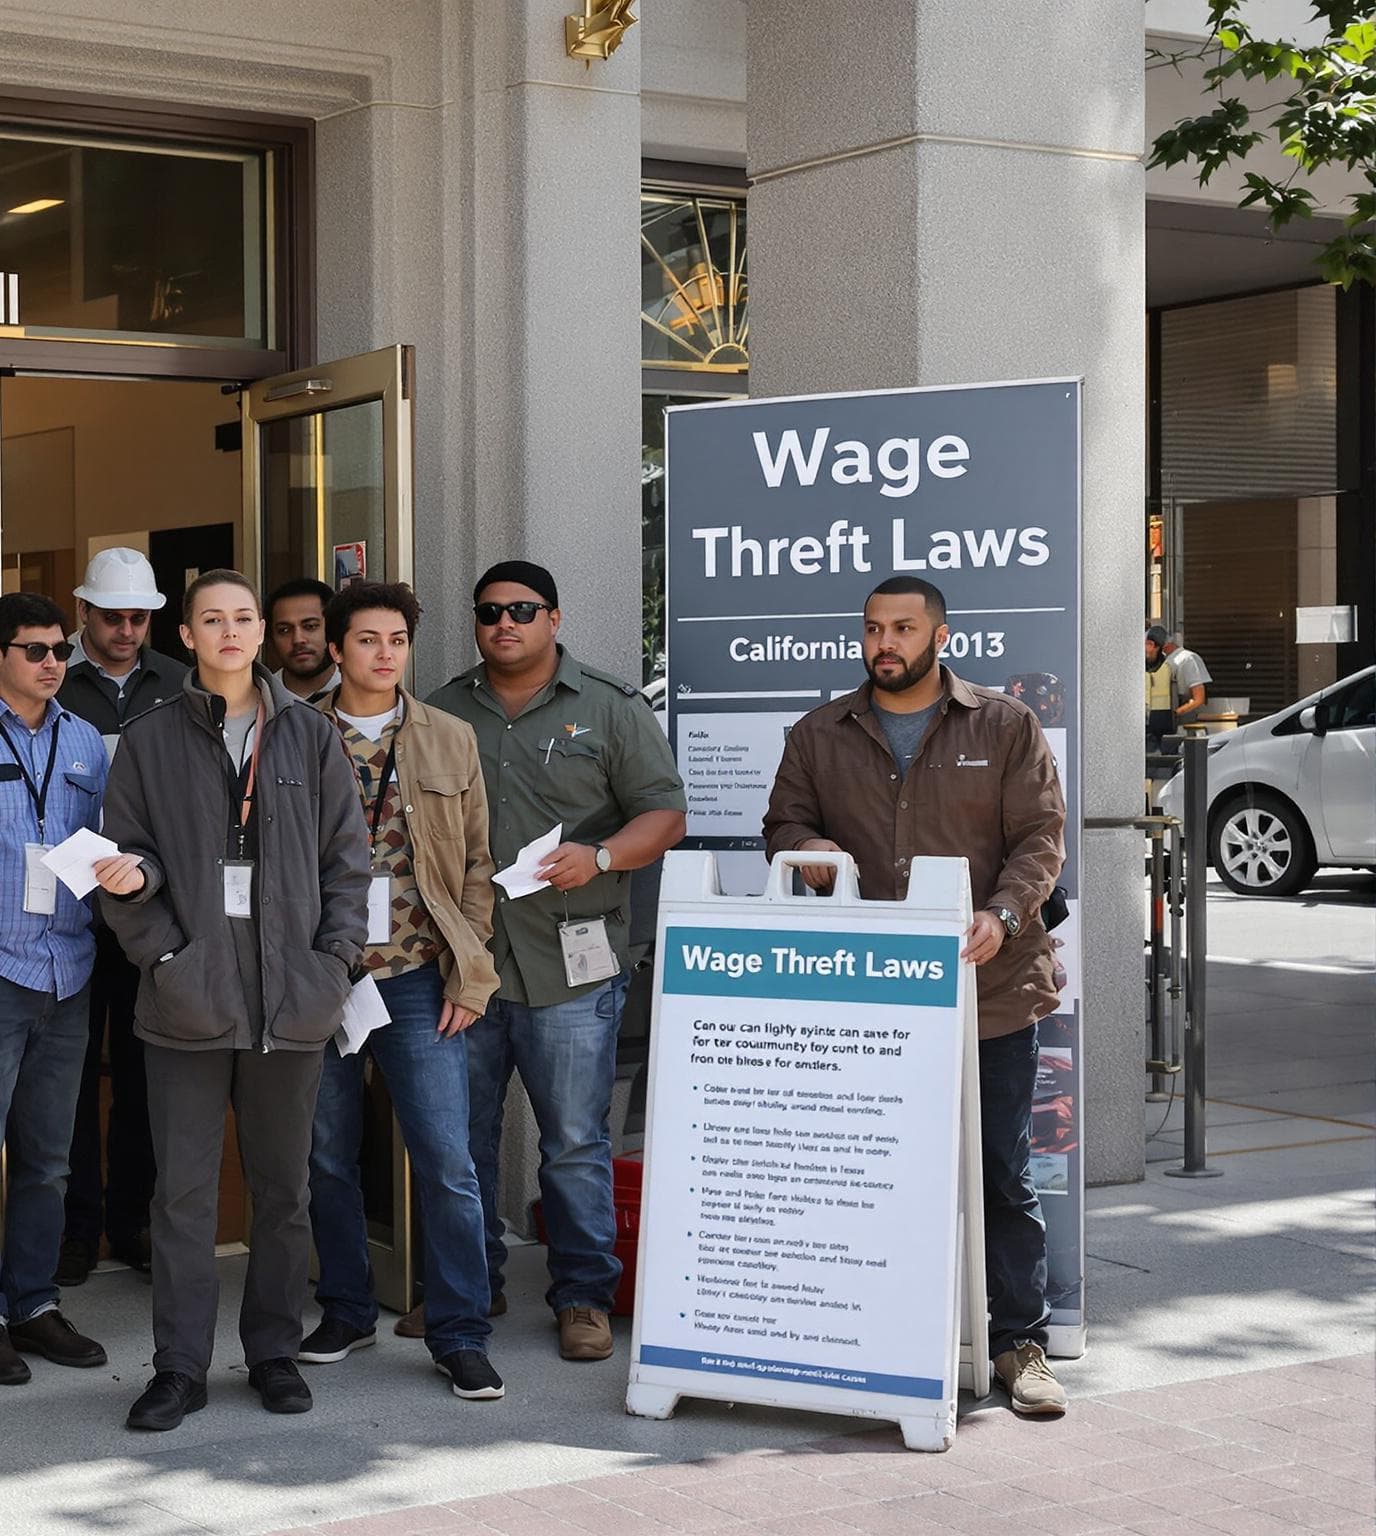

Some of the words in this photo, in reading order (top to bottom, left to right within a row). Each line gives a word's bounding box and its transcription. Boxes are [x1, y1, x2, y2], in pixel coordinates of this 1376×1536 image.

[752, 427, 970, 498] Wage
[692, 520, 872, 577] Threft
[892, 518, 1050, 571] Laws
[729, 635, 863, 662] California
[682, 945, 762, 978] Wage
[771, 948, 856, 976] Threft
[866, 952, 944, 980] Laws
[740, 1024, 761, 1033] can
[893, 1029, 910, 1040] for
[775, 1057, 792, 1068] for
[880, 1046, 902, 1056] and
